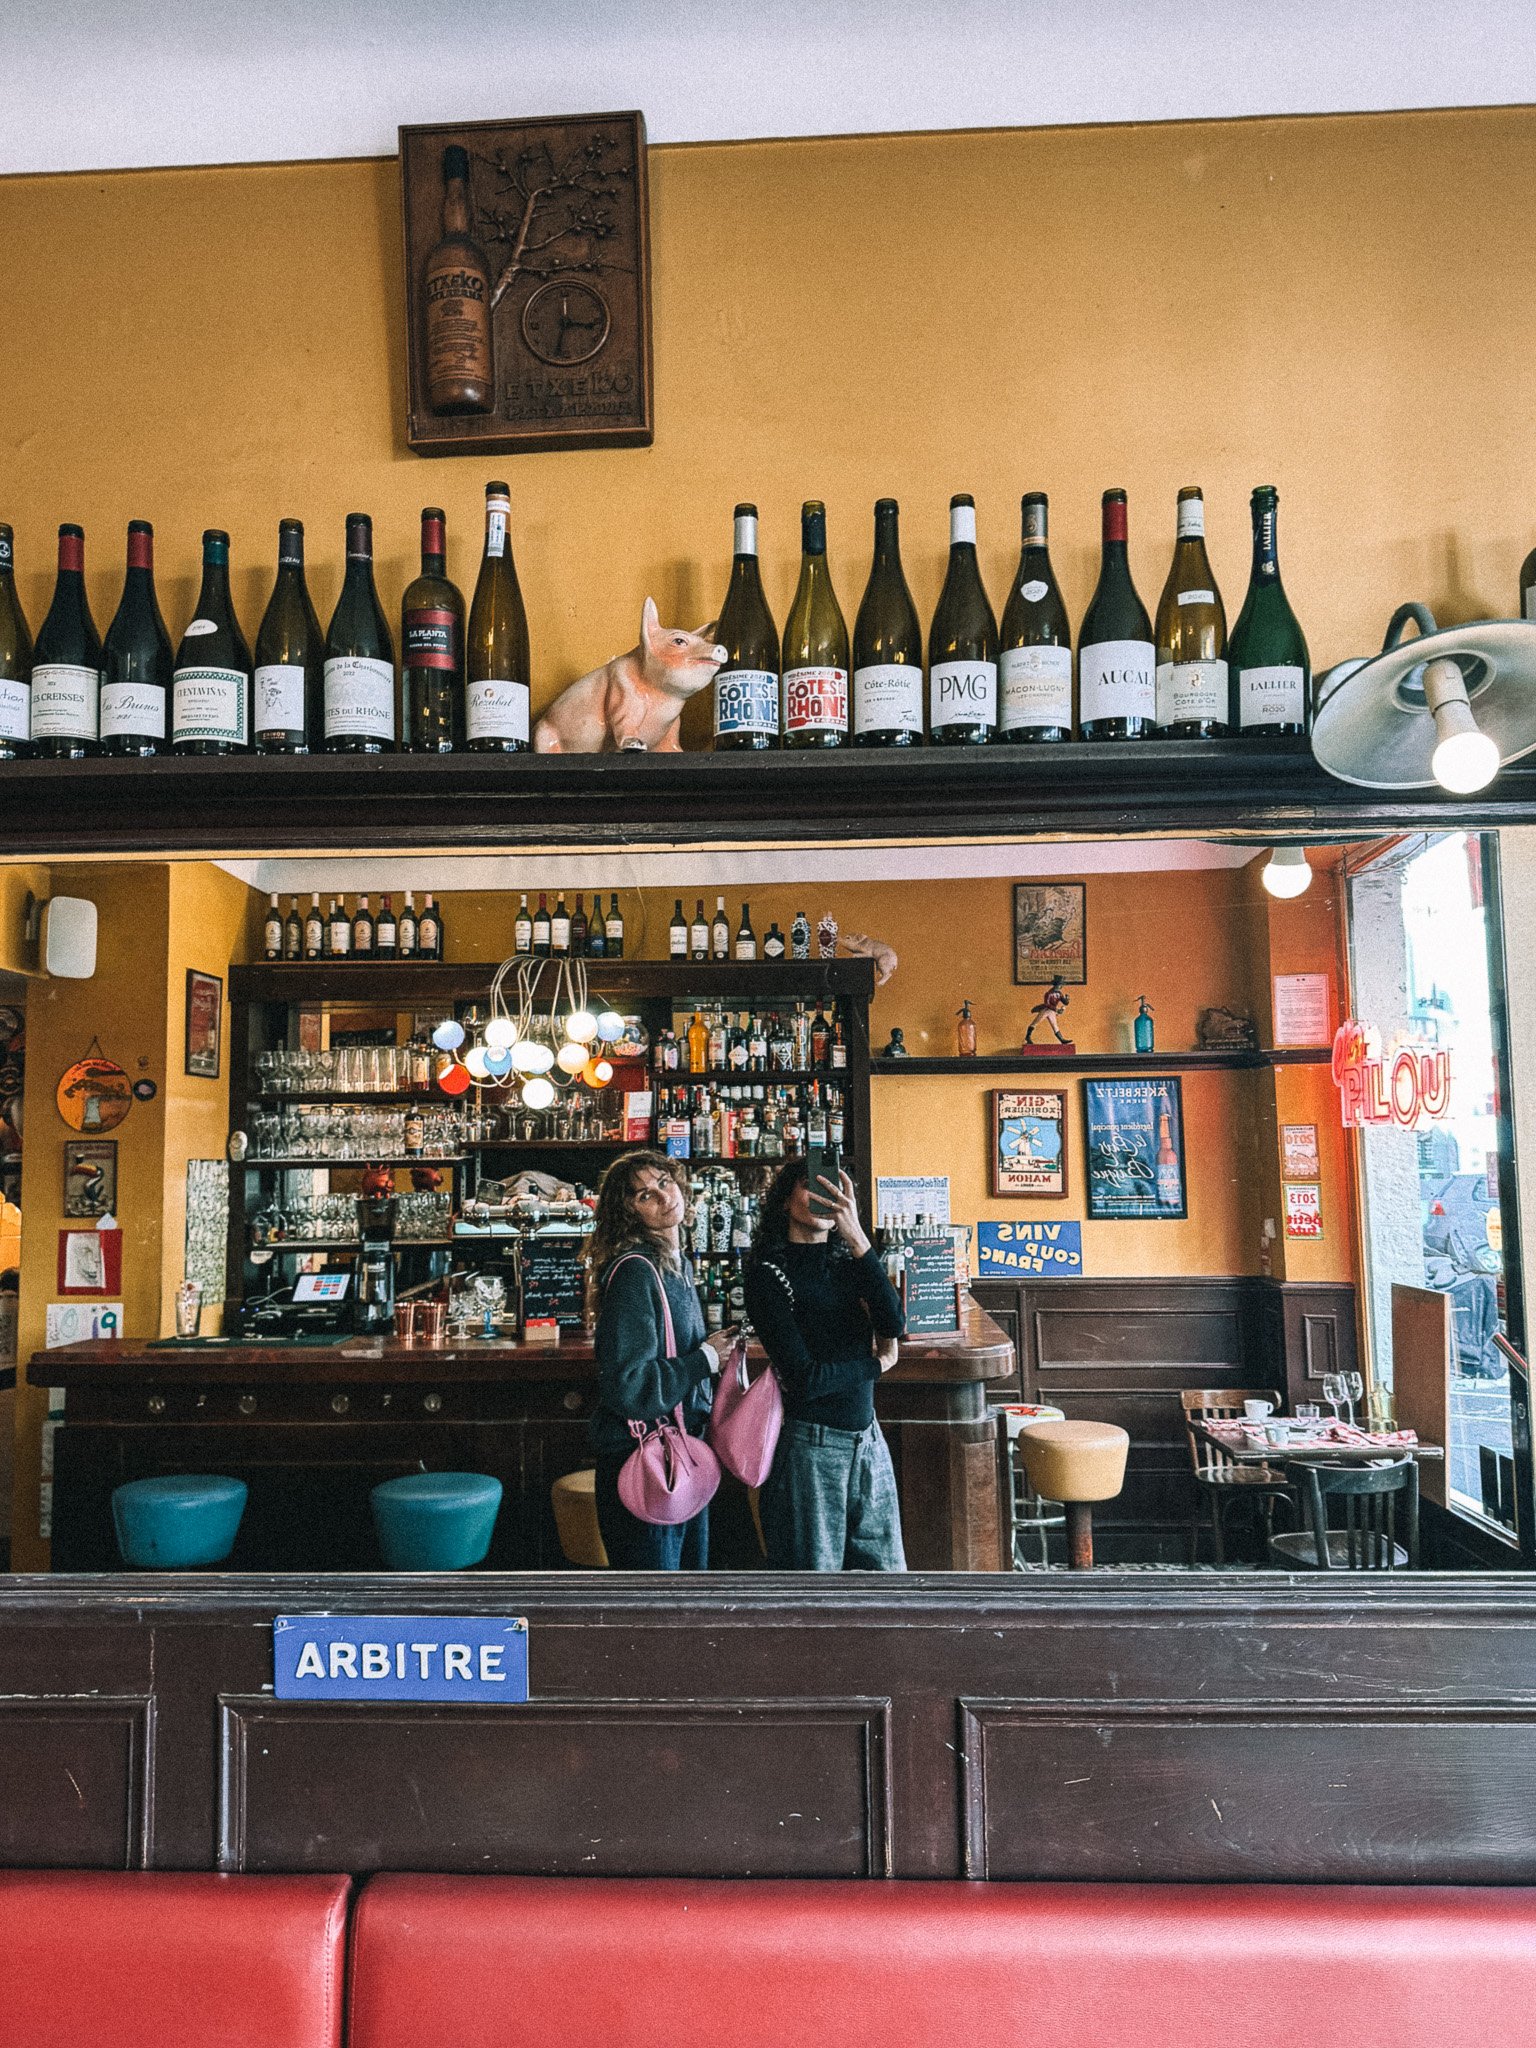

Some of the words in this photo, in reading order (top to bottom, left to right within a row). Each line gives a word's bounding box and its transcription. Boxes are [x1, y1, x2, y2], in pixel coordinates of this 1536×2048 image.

[505, 373, 633, 399] ETXEKO
[1263, 512, 1272, 550] LALLIER
[409, 630, 418, 638] LA
[418, 629, 447, 638] PLANTA
[719, 683, 768, 701] CÔTES
[787, 680, 836, 698] CÔTES
[864, 679, 911, 690] Côte-Rôtie
[938, 674, 987, 702] PMG
[1251, 681, 1296, 691] LALLIER
[41, 692, 85, 703] CREISSES
[787, 696, 846, 719] RHÔNE
[356, 706, 391, 719] RHÔNE
[719, 698, 778, 722] RHÔNE
[1344, 1051, 1445, 1124] PILOU
[296, 1642, 506, 1681] ARBITRE
